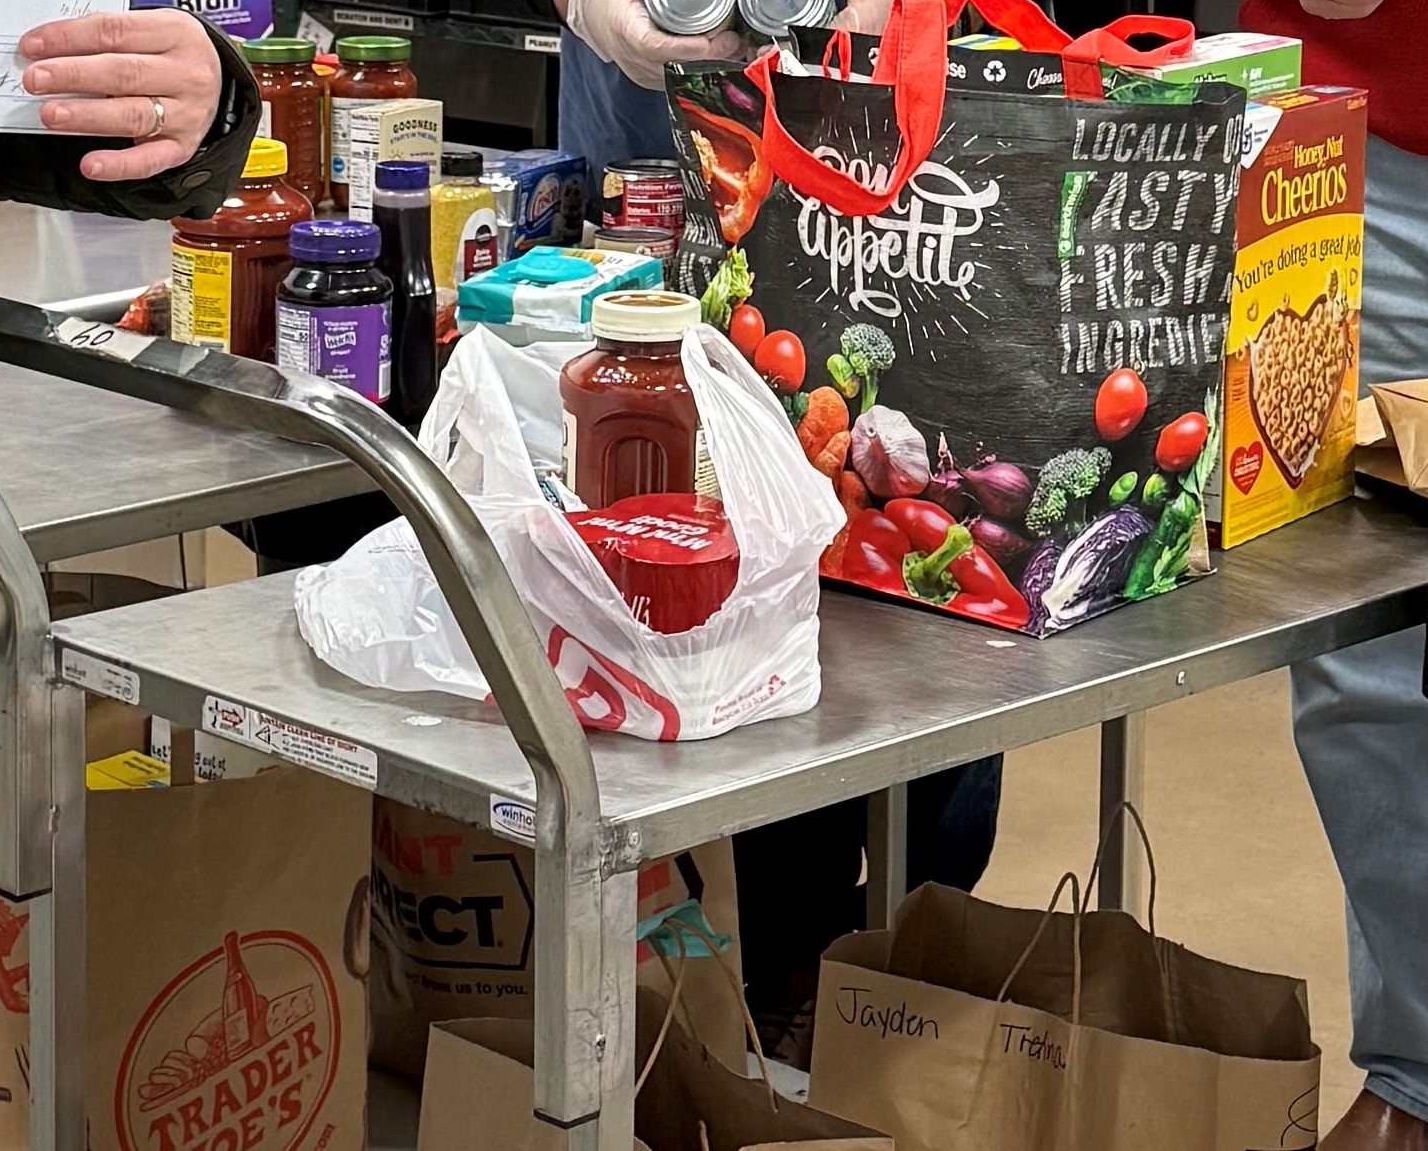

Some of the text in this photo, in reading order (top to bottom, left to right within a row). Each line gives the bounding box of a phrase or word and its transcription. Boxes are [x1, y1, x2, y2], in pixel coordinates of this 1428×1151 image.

[336, 11, 403, 26] SCRATCH AND DENT
[529, 38, 557, 48] PEANUT
[393, 120, 438, 133] GOODNESS
[1073, 119, 1218, 162] LOCALLY
[1294, 135, 1343, 169] Honey Nut
[1085, 170, 1238, 233] ASTY
[1261, 163, 1347, 226] Cheerios
[789, 161, 1000, 317] appetit
[1060, 242, 1217, 312] FRESH
[1236, 234, 1360, 293] You're doing a great job
[287, 724, 358, 752] CLEAN LINE OF SIGHT
[455, 984, 472, 994] us
[476, 981, 491, 994] to
[836, 987, 939, 1040] Jayden
[148, 1022, 322, 1151] TRADER
